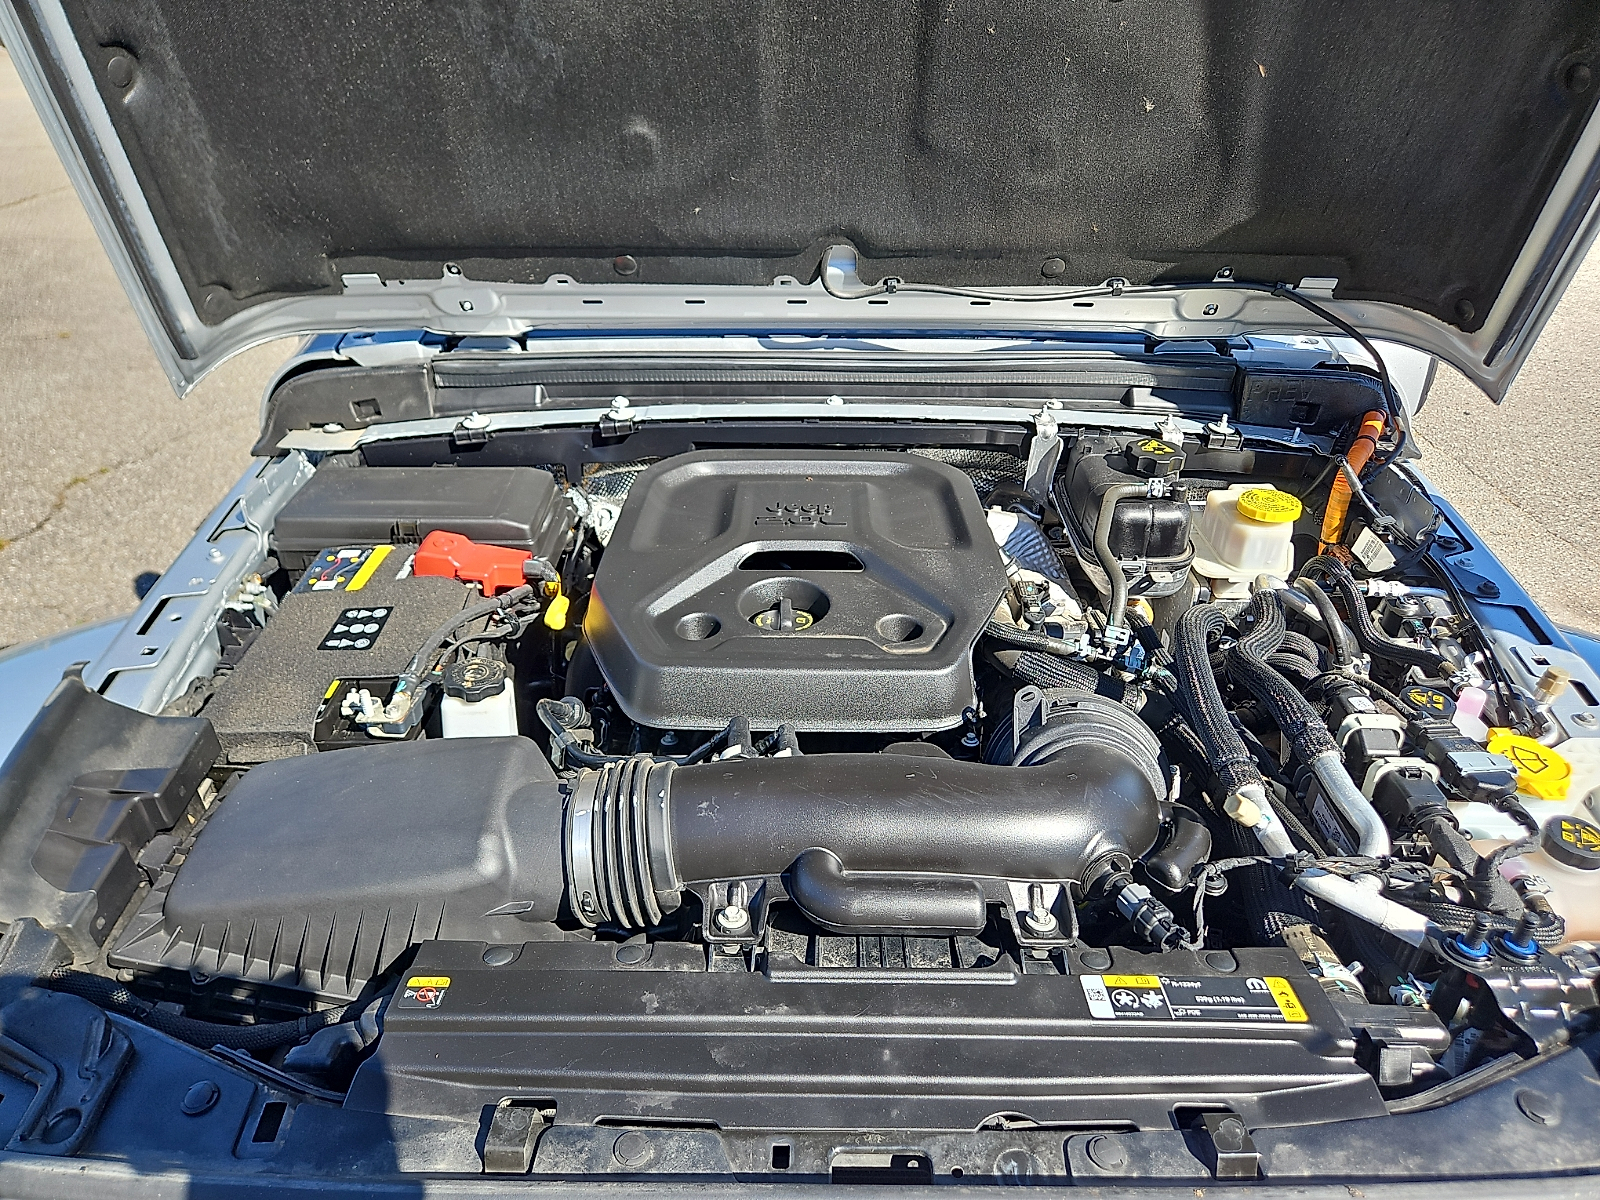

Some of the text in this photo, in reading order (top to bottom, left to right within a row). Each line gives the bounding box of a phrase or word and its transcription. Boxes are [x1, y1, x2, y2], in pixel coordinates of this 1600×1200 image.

[1247, 379, 1318, 402] PHEV
[765, 501, 833, 516] Jeep
[754, 516, 848, 527] 2.0L
